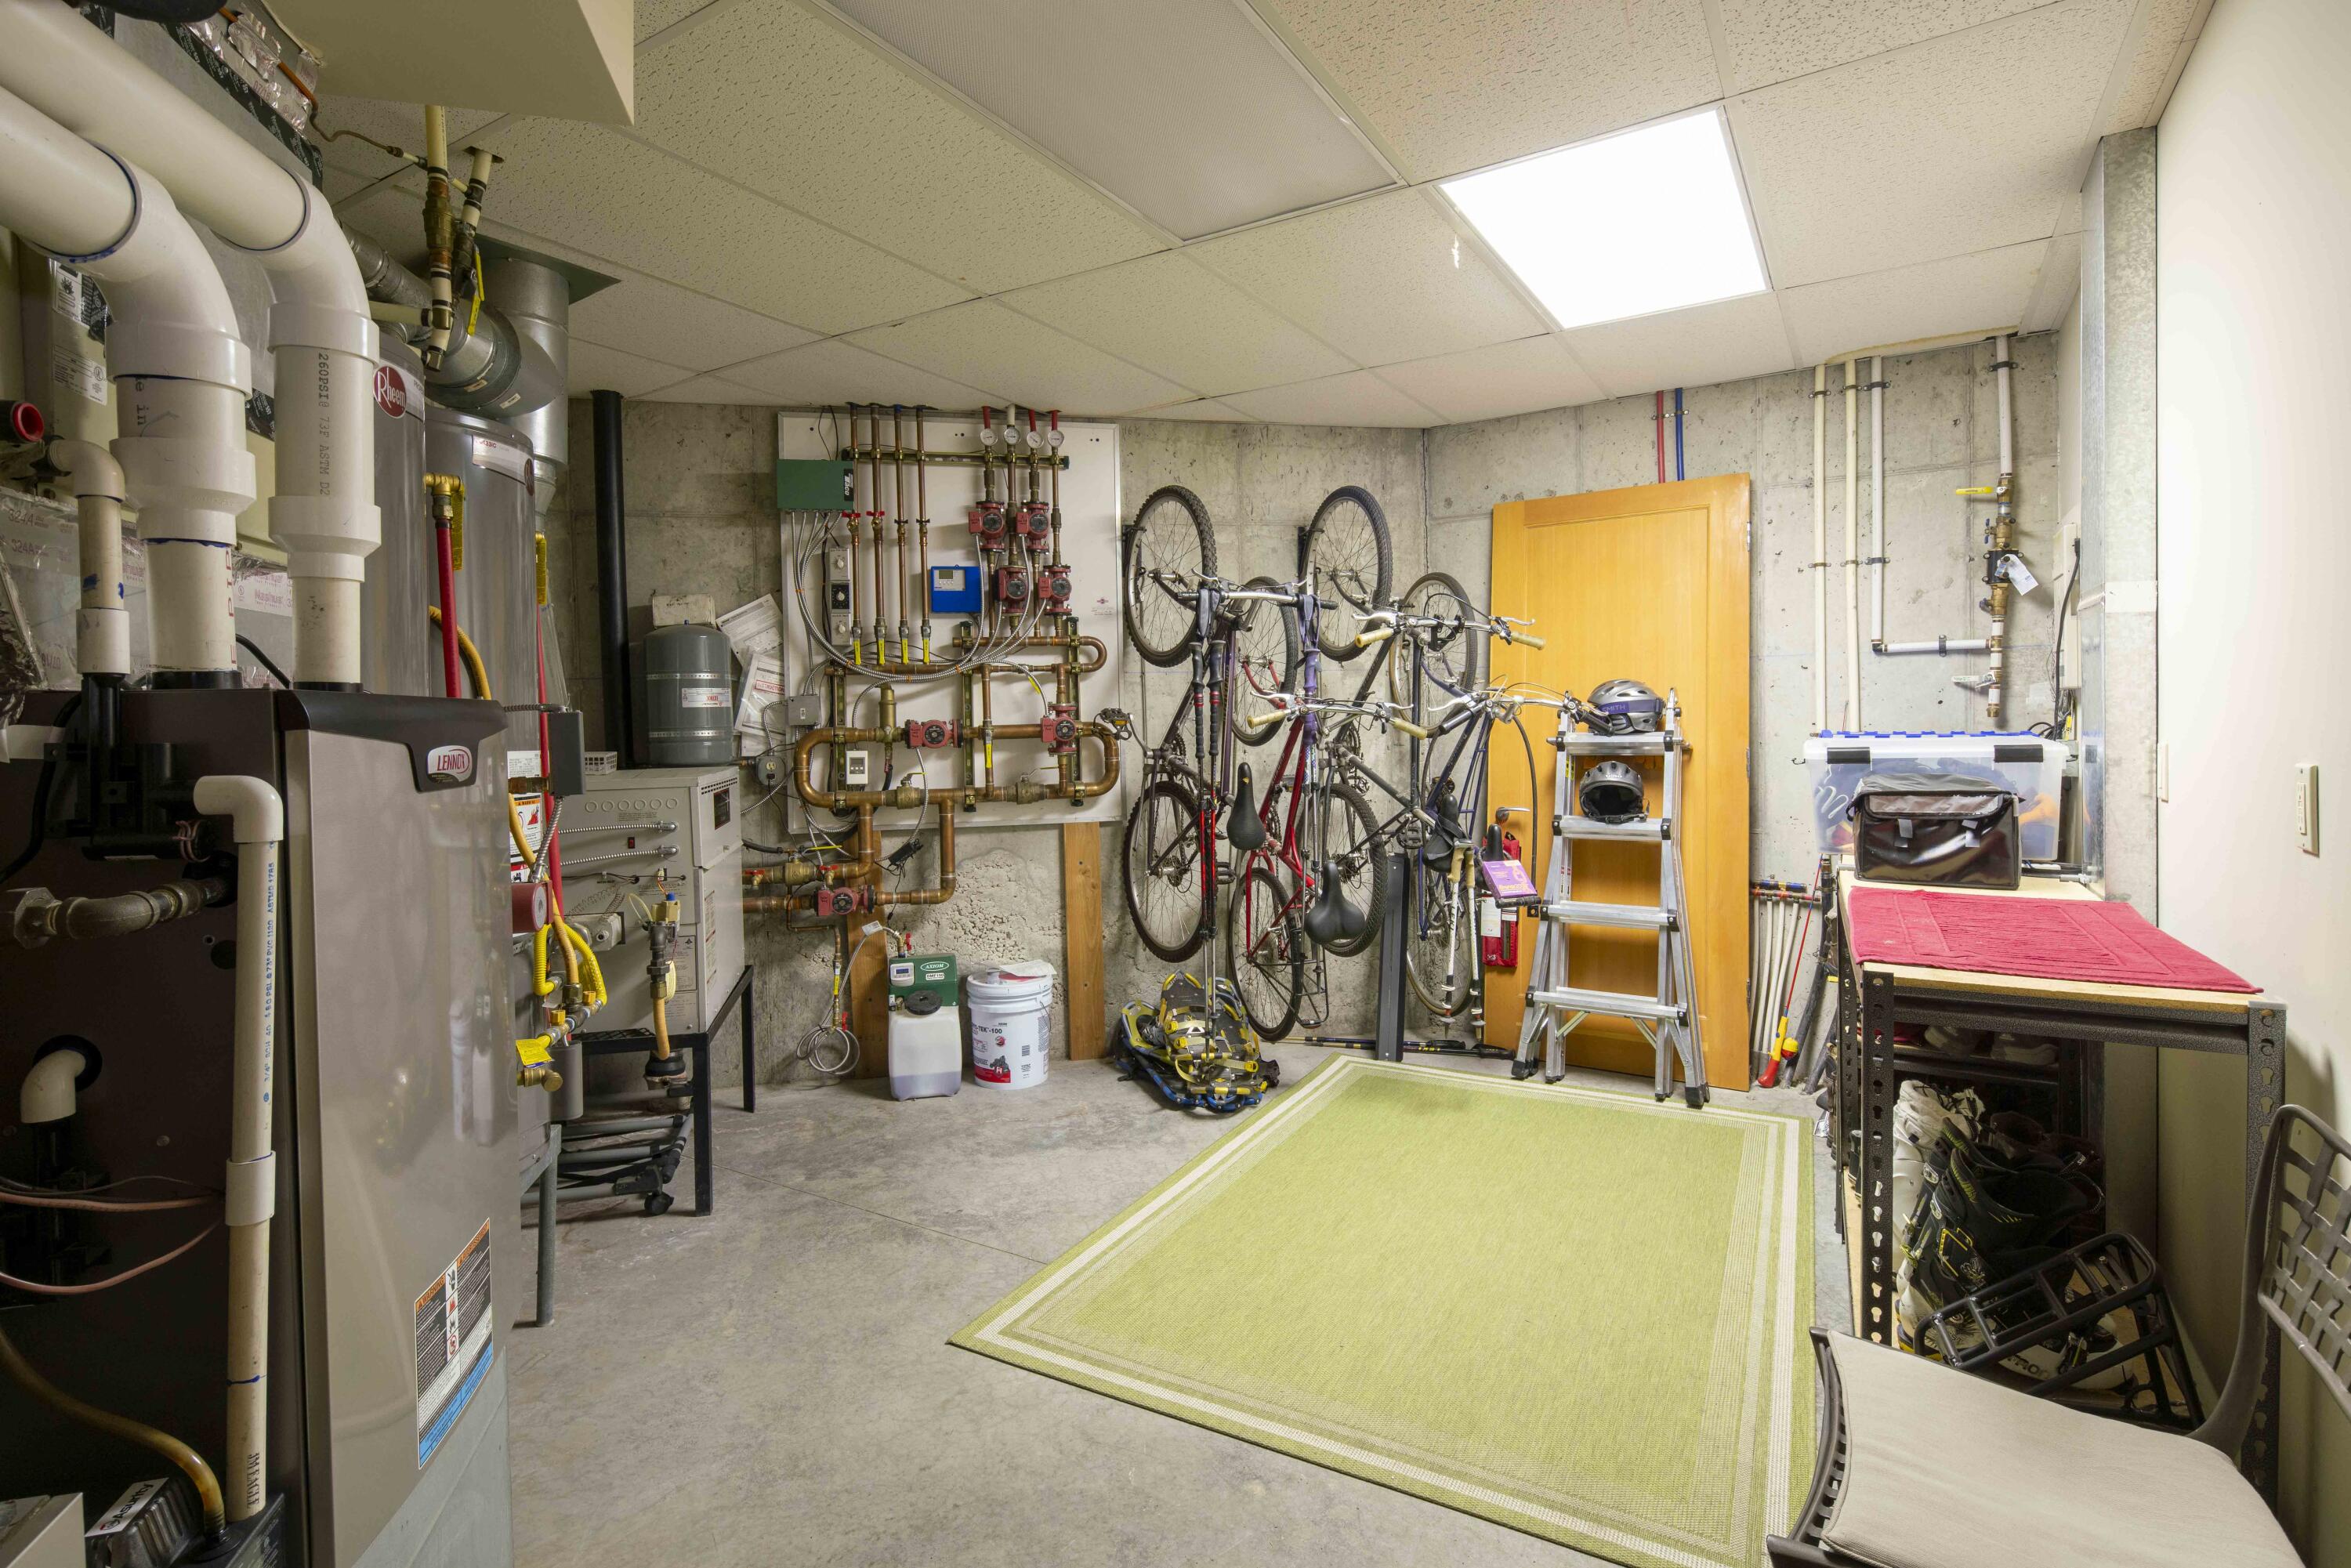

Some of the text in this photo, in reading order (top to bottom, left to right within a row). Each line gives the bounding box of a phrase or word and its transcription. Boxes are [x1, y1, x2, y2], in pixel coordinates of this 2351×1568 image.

[377, 367, 406, 409] Rheem
[319, 416, 330, 440] 73F
[319, 444, 330, 476] ASTM
[8, 509, 34, 527] 324A
[11, 538, 34, 556] 324A
[437, 754, 465, 772] LENNOX
[422, 1276, 445, 1304] WARNING
[113, 1483, 154, 1519] Asurity
